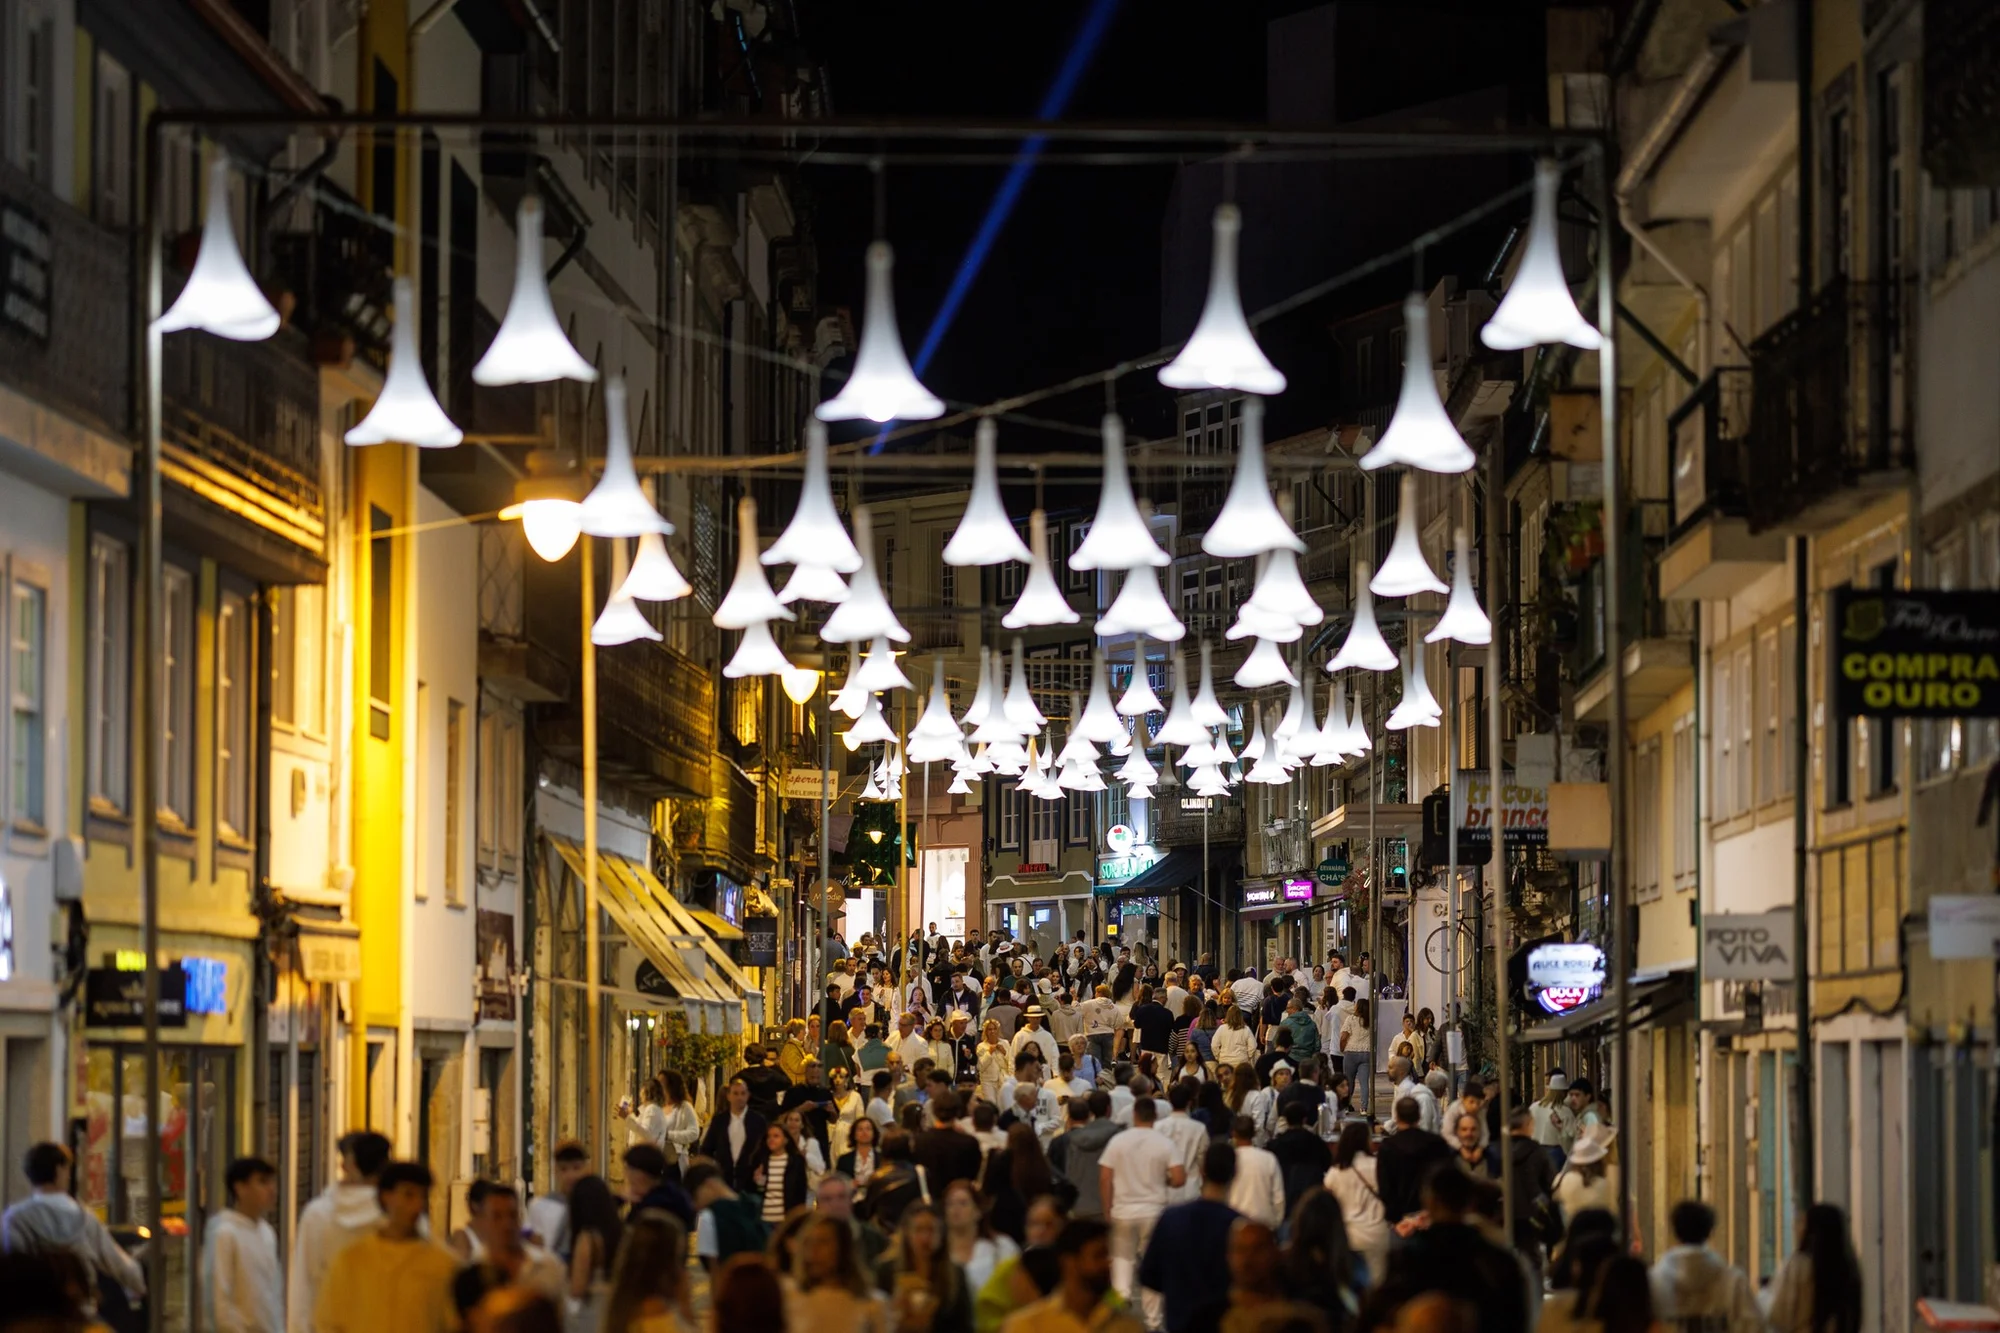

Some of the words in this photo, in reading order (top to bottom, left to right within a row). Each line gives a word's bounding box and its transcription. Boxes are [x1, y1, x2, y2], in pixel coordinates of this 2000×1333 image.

[1842, 652, 1999, 681] COMPRA
[1863, 681, 1981, 708] OURO
[1706, 927, 1770, 945] FOTO
[1717, 944, 1789, 966] VIVA
